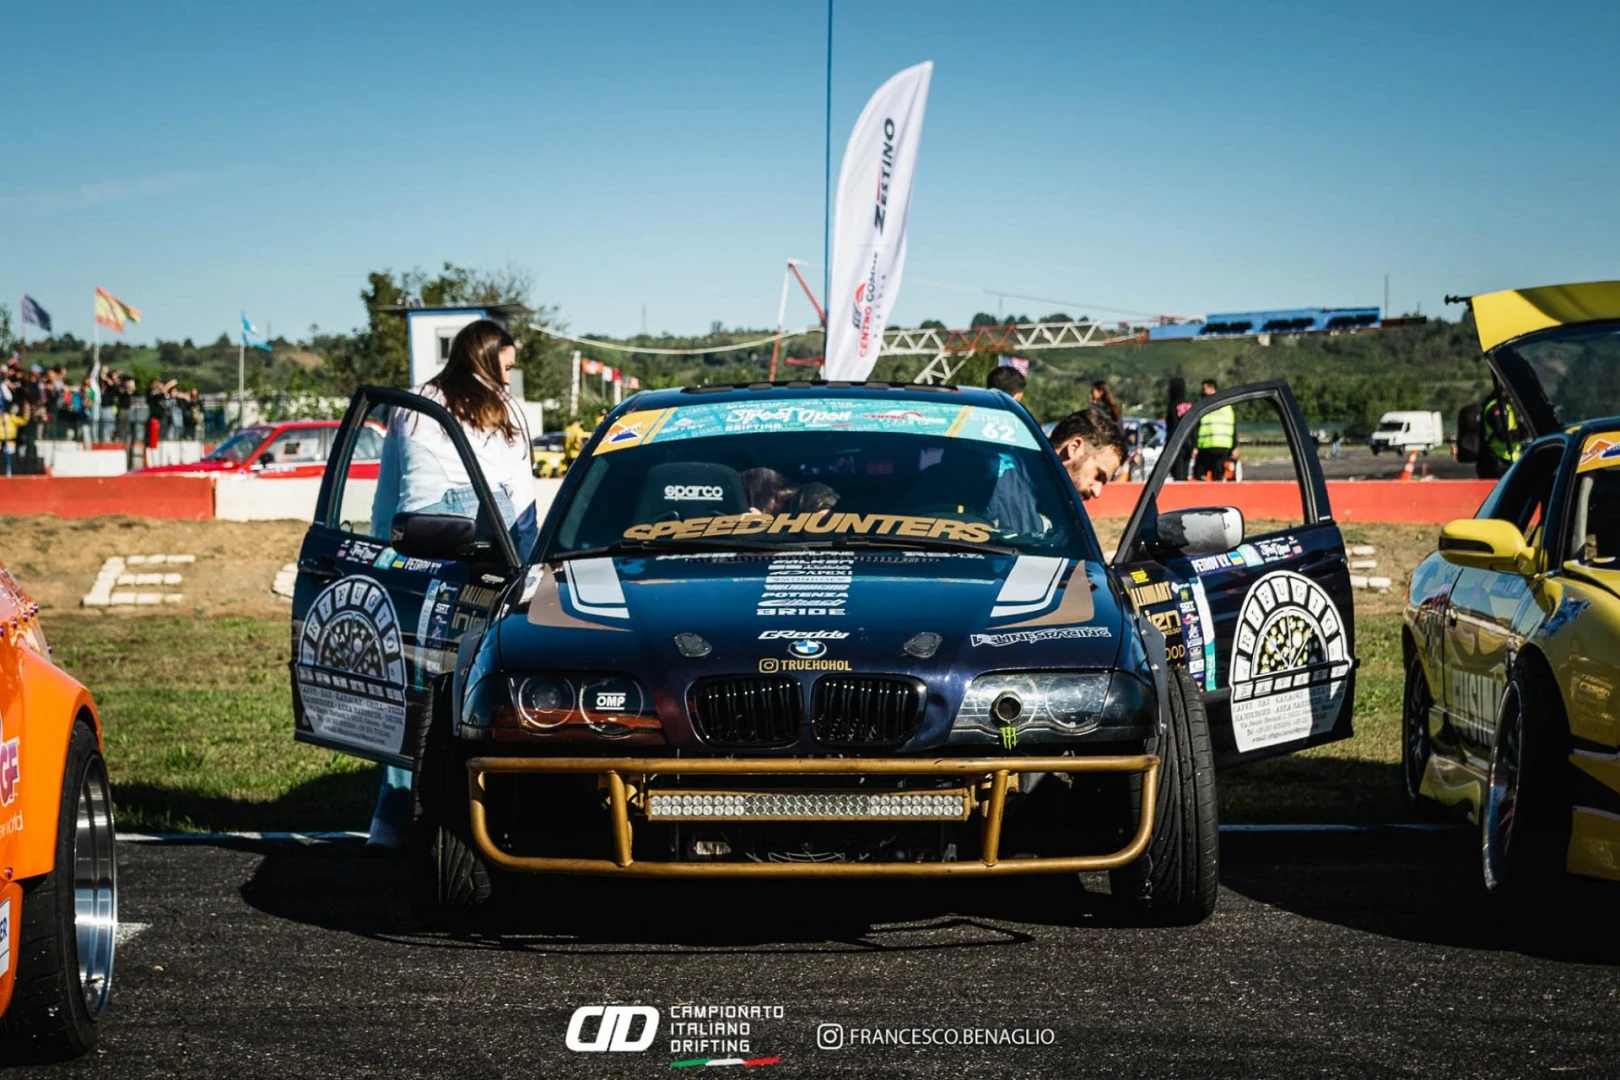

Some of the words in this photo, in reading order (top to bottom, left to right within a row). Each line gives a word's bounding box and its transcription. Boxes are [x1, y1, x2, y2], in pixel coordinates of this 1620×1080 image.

[874, 117, 895, 238] ZESTINO
[982, 422, 1017, 443] 62
[623, 512, 992, 543] SPEEDHUNTERS
[756, 608, 846, 616] BRIDE
[758, 630, 850, 639] GReddy
[780, 660, 853, 671] TRUEHOHOL
[595, 693, 627, 709] OMP
